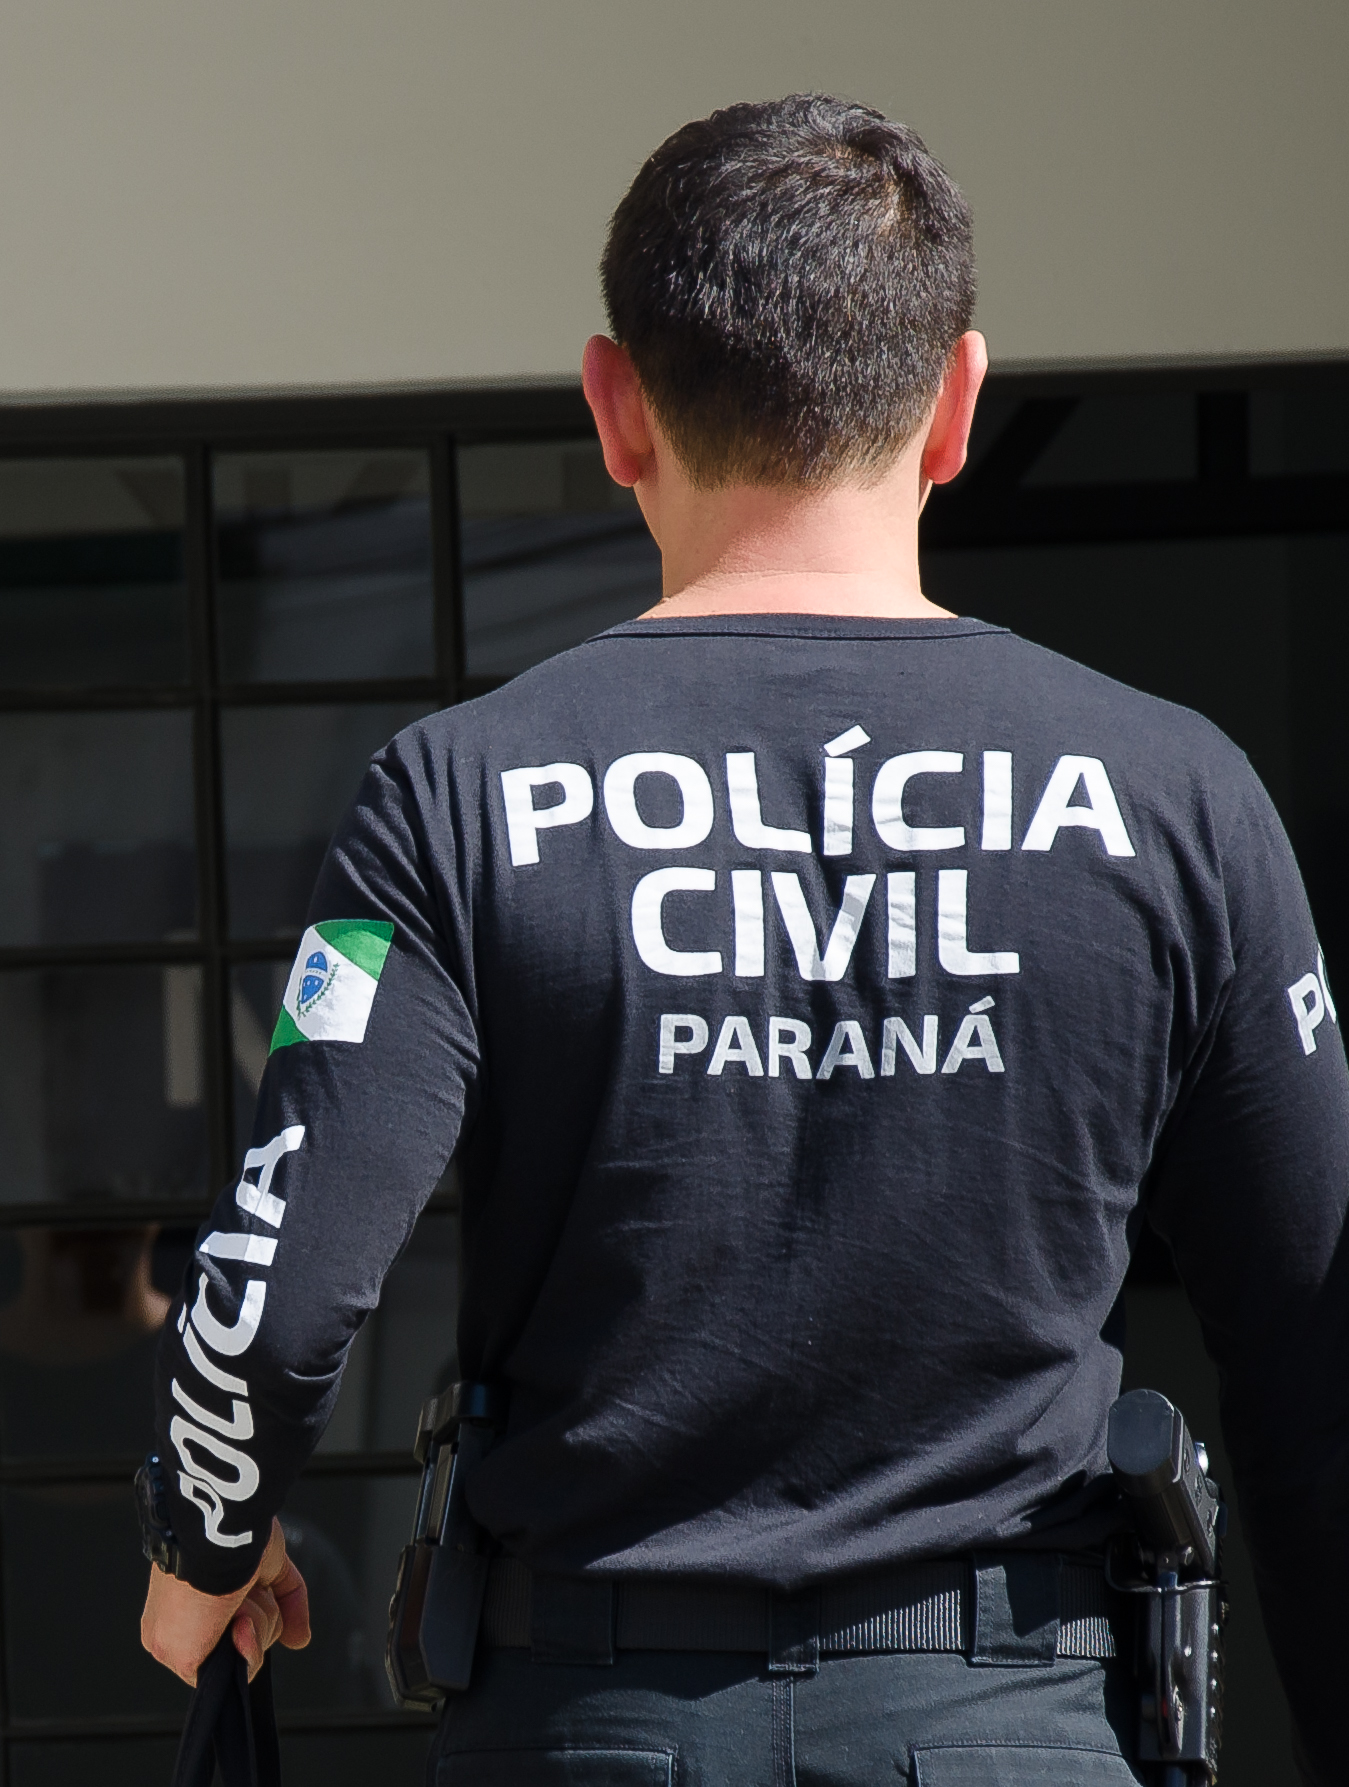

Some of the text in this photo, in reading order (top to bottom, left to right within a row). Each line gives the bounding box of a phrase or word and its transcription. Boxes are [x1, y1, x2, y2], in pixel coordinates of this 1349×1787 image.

[499, 724, 1136, 867] POLÍCIA
[631, 866, 1021, 982] CIVIL
[658, 995, 1005, 1081] PARANÁ
[169, 1124, 307, 1549] POLÍCIA
